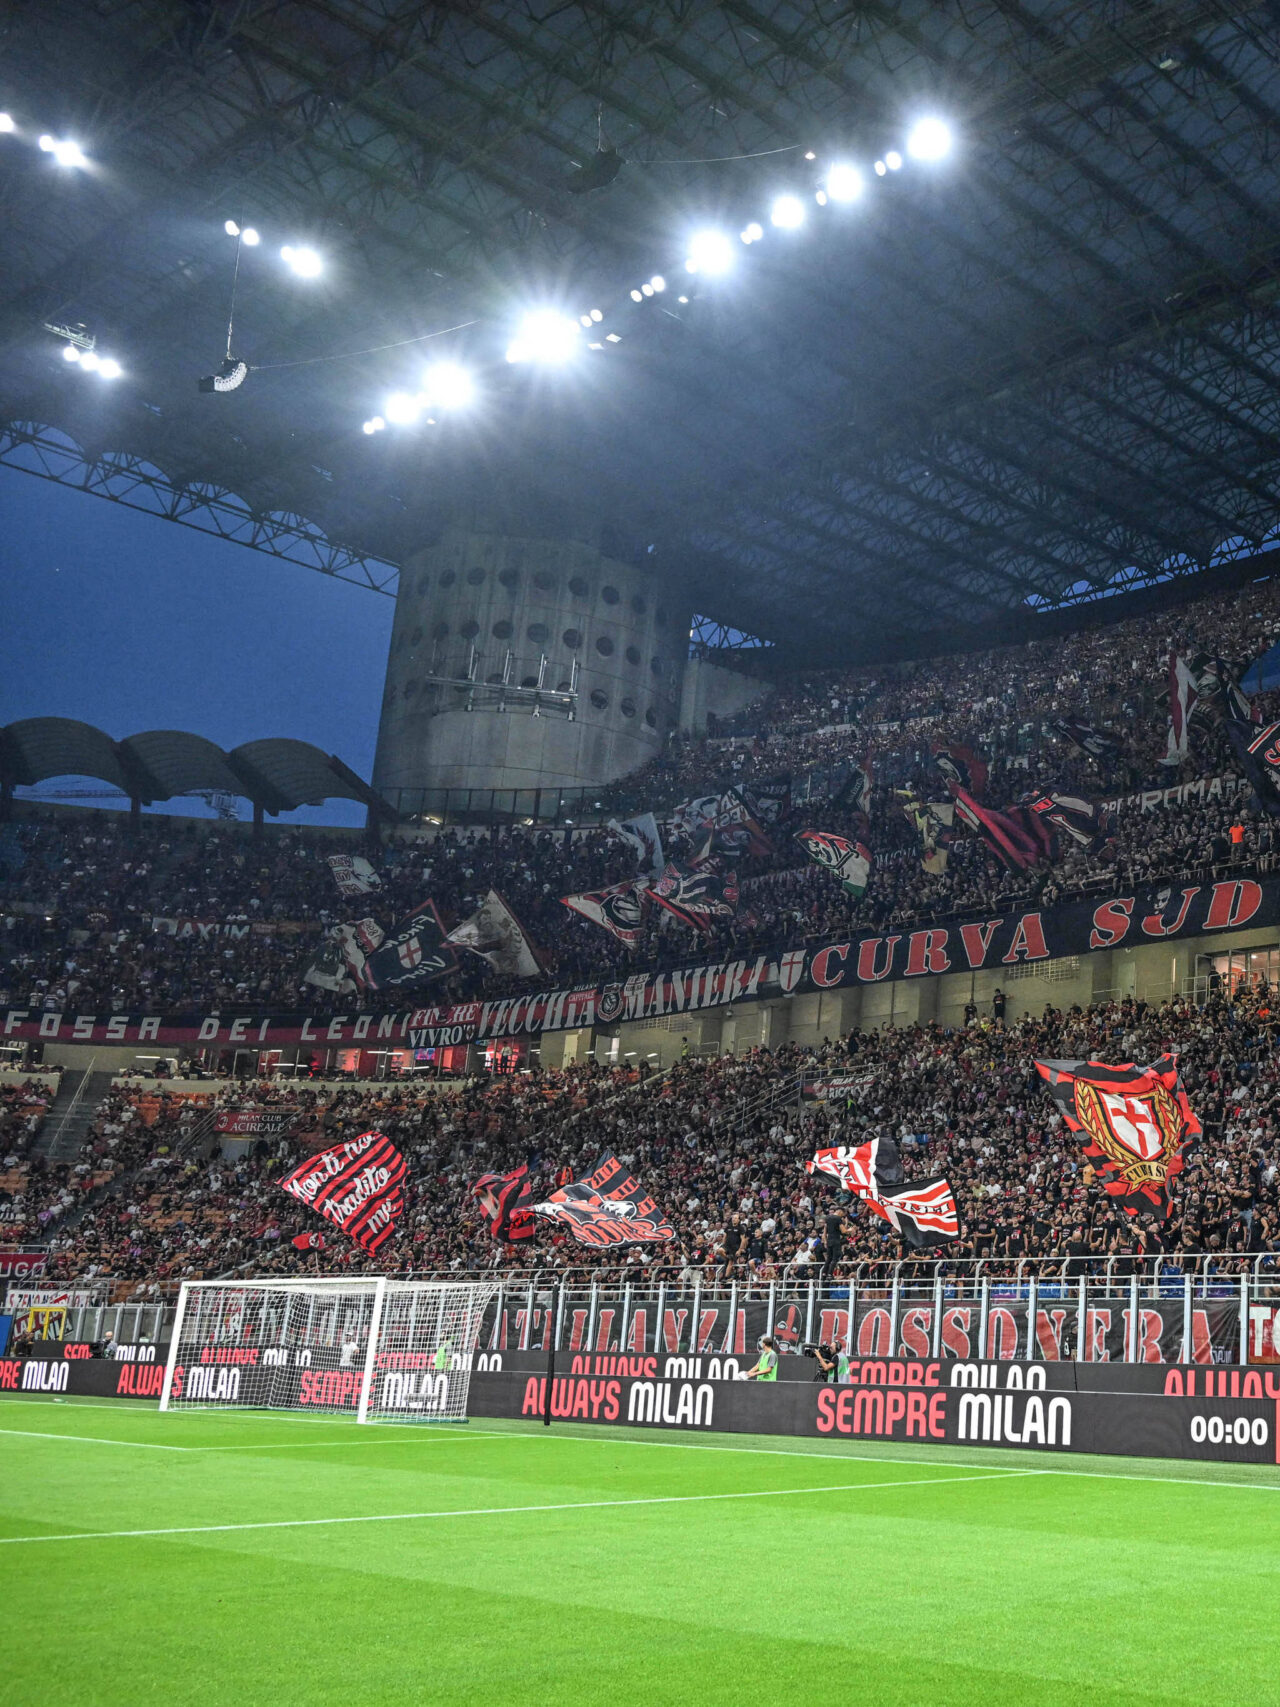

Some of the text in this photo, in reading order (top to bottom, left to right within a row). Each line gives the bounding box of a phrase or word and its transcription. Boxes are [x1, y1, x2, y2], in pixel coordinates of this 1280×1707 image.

[809, 912, 1051, 987] CURVA
[1088, 879, 1264, 950] SUD
[4, 1010, 411, 1041] FOSSA DEI LEONI
[478, 990, 595, 1038] VECCHIA
[237, 1114, 282, 1122] MILAN CLUB
[323, 1165, 392, 1224] tradito
[22, 1362, 70, 1391] MILAN
[117, 1364, 241, 1400] ALWAS MILAN
[382, 1372, 449, 1410] MILAN
[848, 1361, 941, 1386] EMPRE
[522, 1376, 714, 1426] ALWAYS MILAN
[816, 1388, 1072, 1446] SEMPRE MILAN
[1190, 1415, 1268, 1446] 00:00
